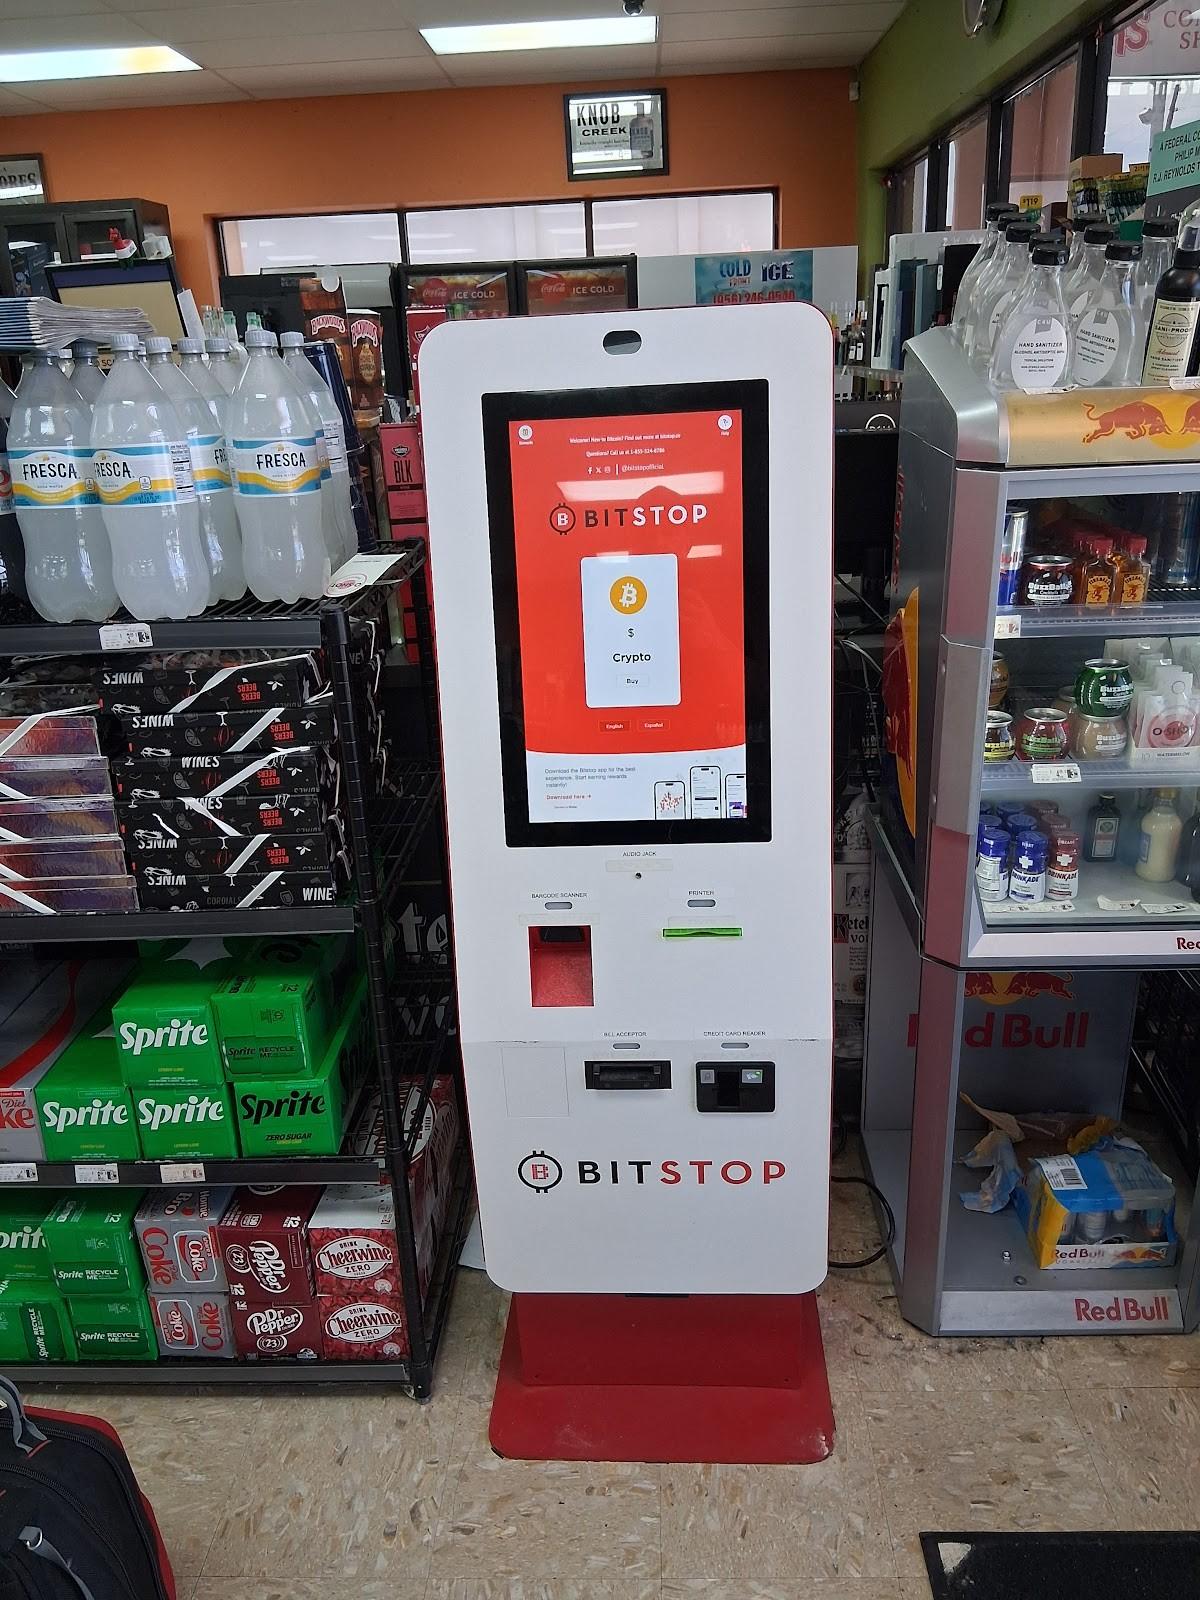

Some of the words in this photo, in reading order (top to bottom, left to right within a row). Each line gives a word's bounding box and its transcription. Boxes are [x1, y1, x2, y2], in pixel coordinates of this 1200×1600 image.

[577, 103, 620, 127] KNOB
[582, 127, 627, 136] CREEK
[1164, 133, 1191, 150] FEDERAL
[1175, 148, 1194, 161] PHILIP
[1163, 162, 1196, 180] REYNOLDS
[720, 259, 751, 278] COLD
[761, 261, 794, 282] ICE
[454, 291, 468, 299] ICE
[471, 291, 496, 299] COLD
[590, 286, 615, 294] COLD
[1091, 333, 1115, 343] SANITIZER
[256, 452, 306, 470] FRESCA
[23, 463, 78, 480] FRESCA
[393, 459, 414, 484] BLK
[585, 504, 708, 528] BITSTOP
[613, 653, 651, 664] Crypto
[103, 672, 144, 685] WINES
[238, 682, 257, 692] BEERS
[241, 691, 261, 701] BEERS
[132, 714, 174, 728] WINES
[270, 722, 290, 732] BEERS
[274, 730, 294, 741] BEERS
[181, 755, 220, 768] WINES
[257, 769, 277, 778] BEERS
[260, 777, 280, 787] BEERS
[259, 810, 280, 819] BEERS
[263, 817, 283, 826] BEERS
[138, 838, 178, 849] WINES
[267, 848, 286, 857] BEERS
[270, 856, 290, 865] BEERS
[148, 875, 187, 886] WINES
[119, 1018, 209, 1055] Sprite
[1003, 1013, 1089, 1048] Bull
[228, 1046, 257, 1057] Sprite
[138, 1095, 225, 1131] Sprite
[240, 1090, 327, 1125] Sprite
[42, 1098, 129, 1133] Sprite
[265, 1133, 286, 1141] ZERO
[286, 1132, 313, 1140] SUGAR
[578, 1160, 786, 1185] BITSTOP
[339, 1241, 358, 1249] DRINK
[142, 1227, 174, 1286] Coke
[188, 1239, 204, 1273] Coke
[232, 1252, 244, 1266] 23
[317, 1243, 393, 1271] Cheerwine
[249, 1241, 283, 1291] Pepper
[345, 1263, 371, 1274] ZERO
[58, 1270, 84, 1280] Sprite
[234, 1283, 246, 1296] 12
[264, 1309, 285, 1321] Dr
[1075, 1297, 1121, 1322] Red
[1124, 1296, 1169, 1321] Bull
[28, 1308, 40, 1336] RECYCLE
[170, 1310, 186, 1342] Coke
[202, 1301, 224, 1351] Coke
[253, 1311, 298, 1336] Pepper
[326, 1309, 401, 1338] Cheerwine
[80, 1332, 106, 1341] Sprite
[355, 1328, 380, 1338] ZERO
[36, 1334, 49, 1358] Sprite
[265, 1338, 278, 1347] 23
